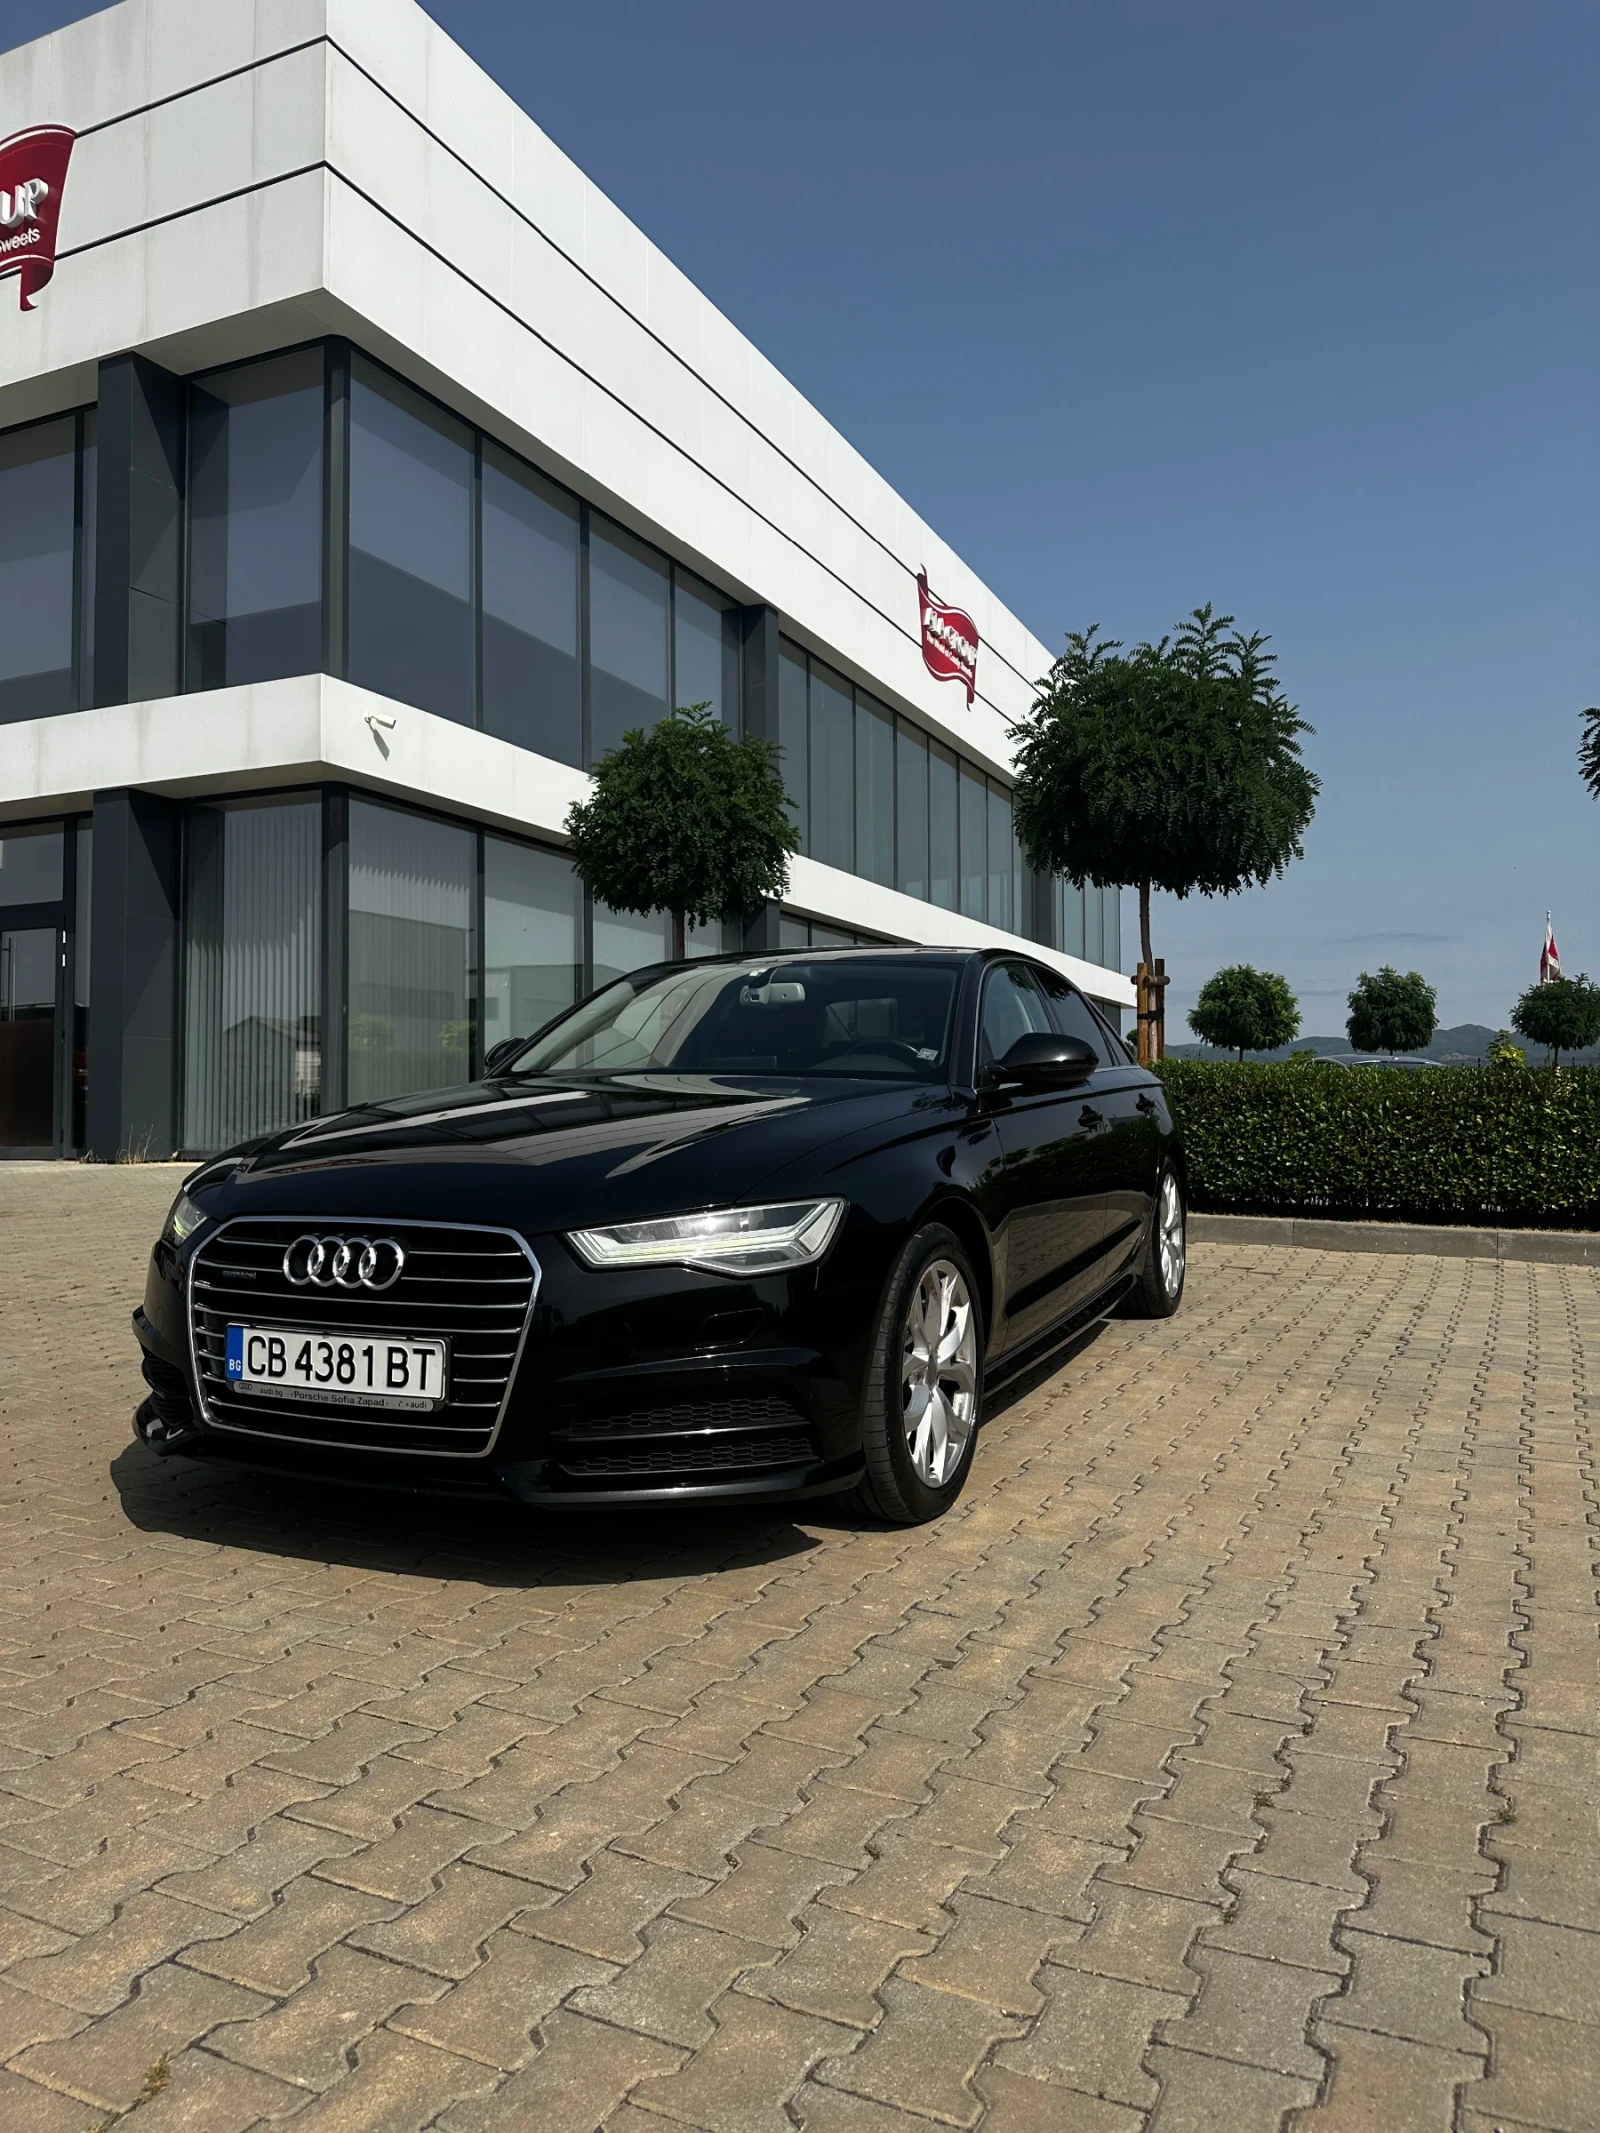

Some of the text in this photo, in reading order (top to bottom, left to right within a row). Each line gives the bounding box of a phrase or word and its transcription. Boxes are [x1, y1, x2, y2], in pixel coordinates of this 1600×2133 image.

[229, 1358, 241, 1371] BG
[247, 1335, 436, 1390] CB 4381 BT
[293, 1390, 385, 1407] Porsche Sofia Zapad
